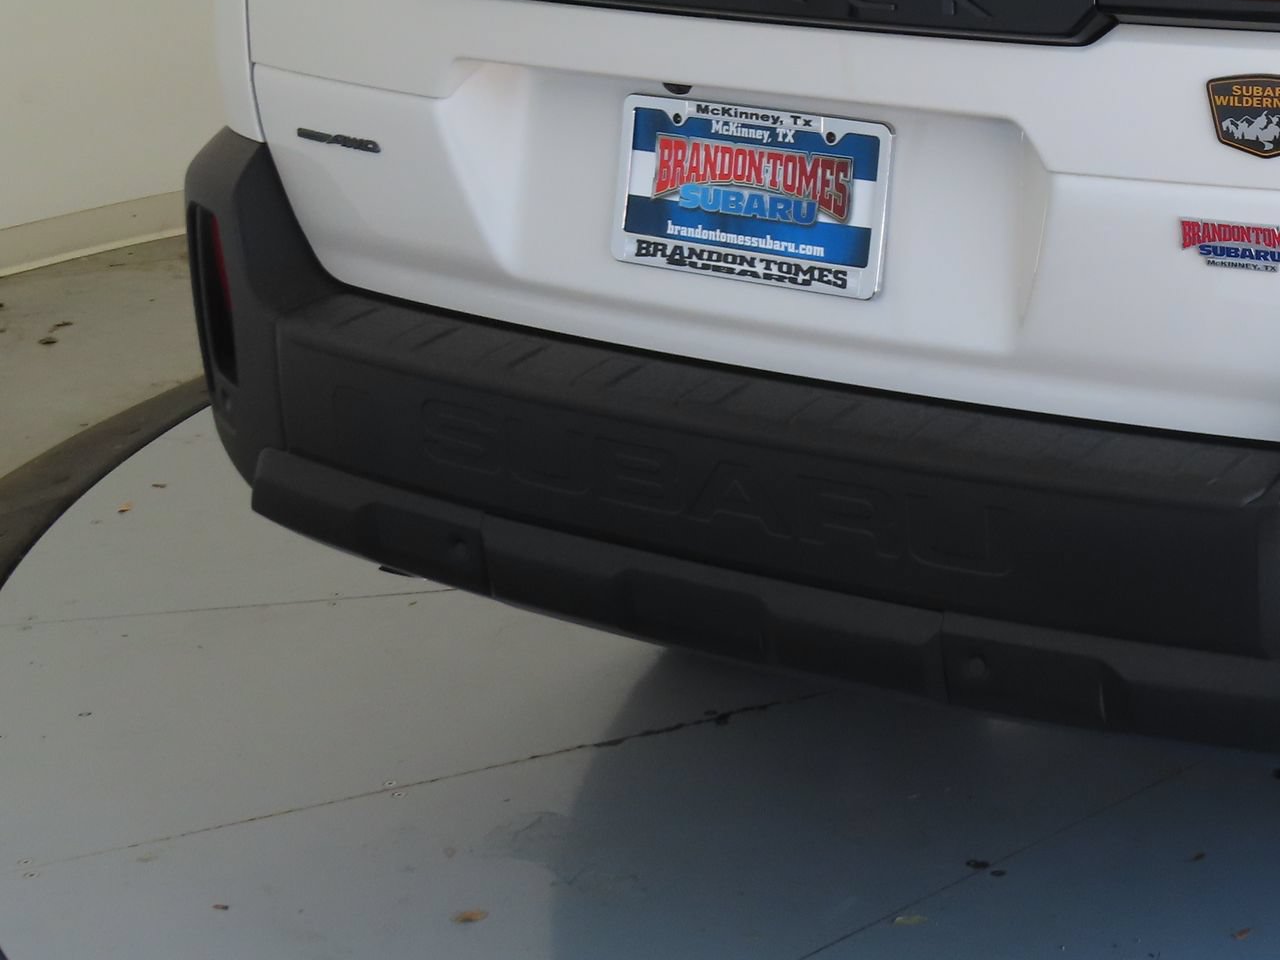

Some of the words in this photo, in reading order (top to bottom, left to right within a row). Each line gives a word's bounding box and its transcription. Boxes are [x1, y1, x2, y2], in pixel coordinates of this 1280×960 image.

[696, 103, 784, 126] McKinney,
[790, 114, 813, 128] Tx
[711, 120, 772, 143] McKinney,
[776, 129, 795, 144] TX
[655, 136, 764, 193] BRANDON
[767, 150, 852, 220] TOMES
[679, 183, 818, 226] SUBARU
[666, 220, 825, 257] brandontomessubaru.com
[1181, 220, 1251, 250] BRANDON
[635, 239, 756, 268] BRANDON
[760, 258, 848, 290] TOMES
[666, 257, 813, 287] SUBARU
[1264, 264, 1278, 273] TX
